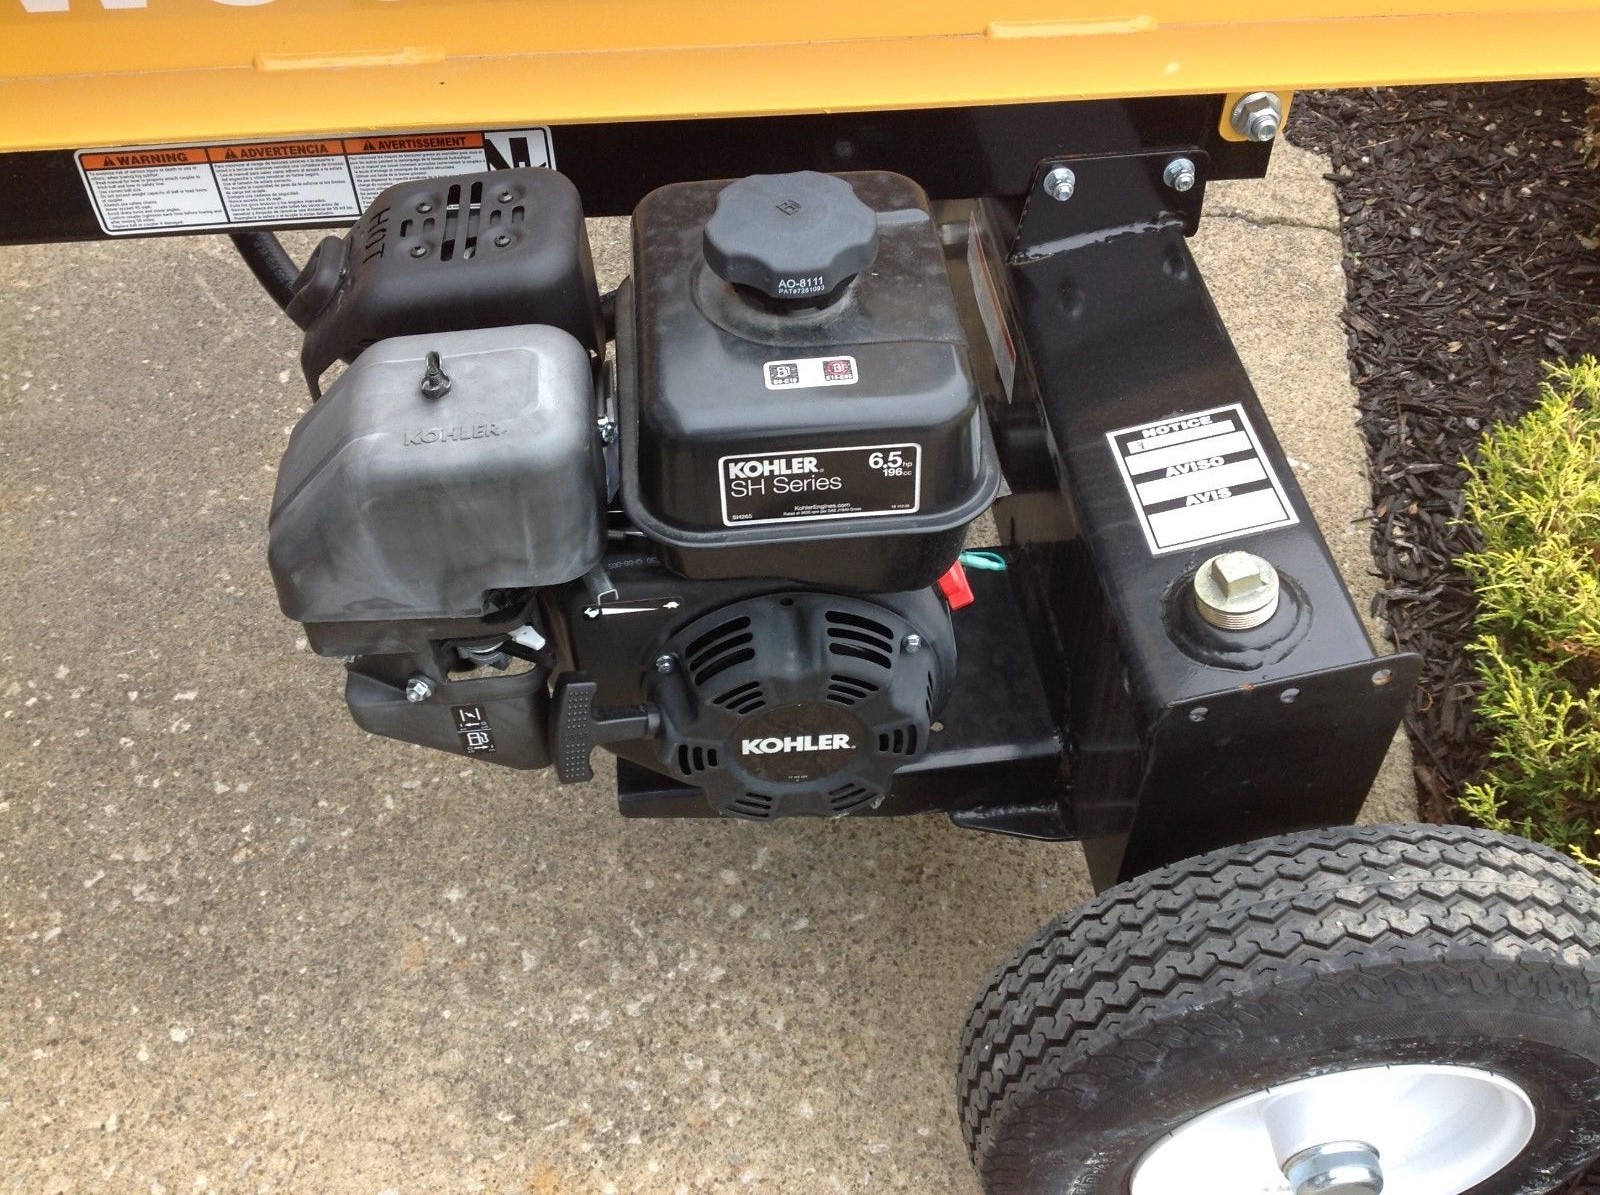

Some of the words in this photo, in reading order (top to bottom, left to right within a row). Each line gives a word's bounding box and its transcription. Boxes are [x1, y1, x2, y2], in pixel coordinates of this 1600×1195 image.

[240, 143, 328, 158] ADVERTENCIA
[378, 136, 466, 150] AVERTISSEMENT
[116, 152, 188, 166] WARNING
[363, 206, 391, 265] HOT
[778, 276, 824, 288] AO-8111
[403, 423, 501, 447] KOHLER
[1141, 415, 1214, 439] NOTICE
[728, 456, 818, 479] KOHLER
[868, 451, 903, 469] 6.5
[1165, 456, 1225, 478] AVISO
[882, 467, 903, 477] 196
[730, 479, 765, 497] SH
[773, 475, 842, 494] Series
[1185, 487, 1233, 507] AVIS
[741, 733, 851, 755] KOHLER
